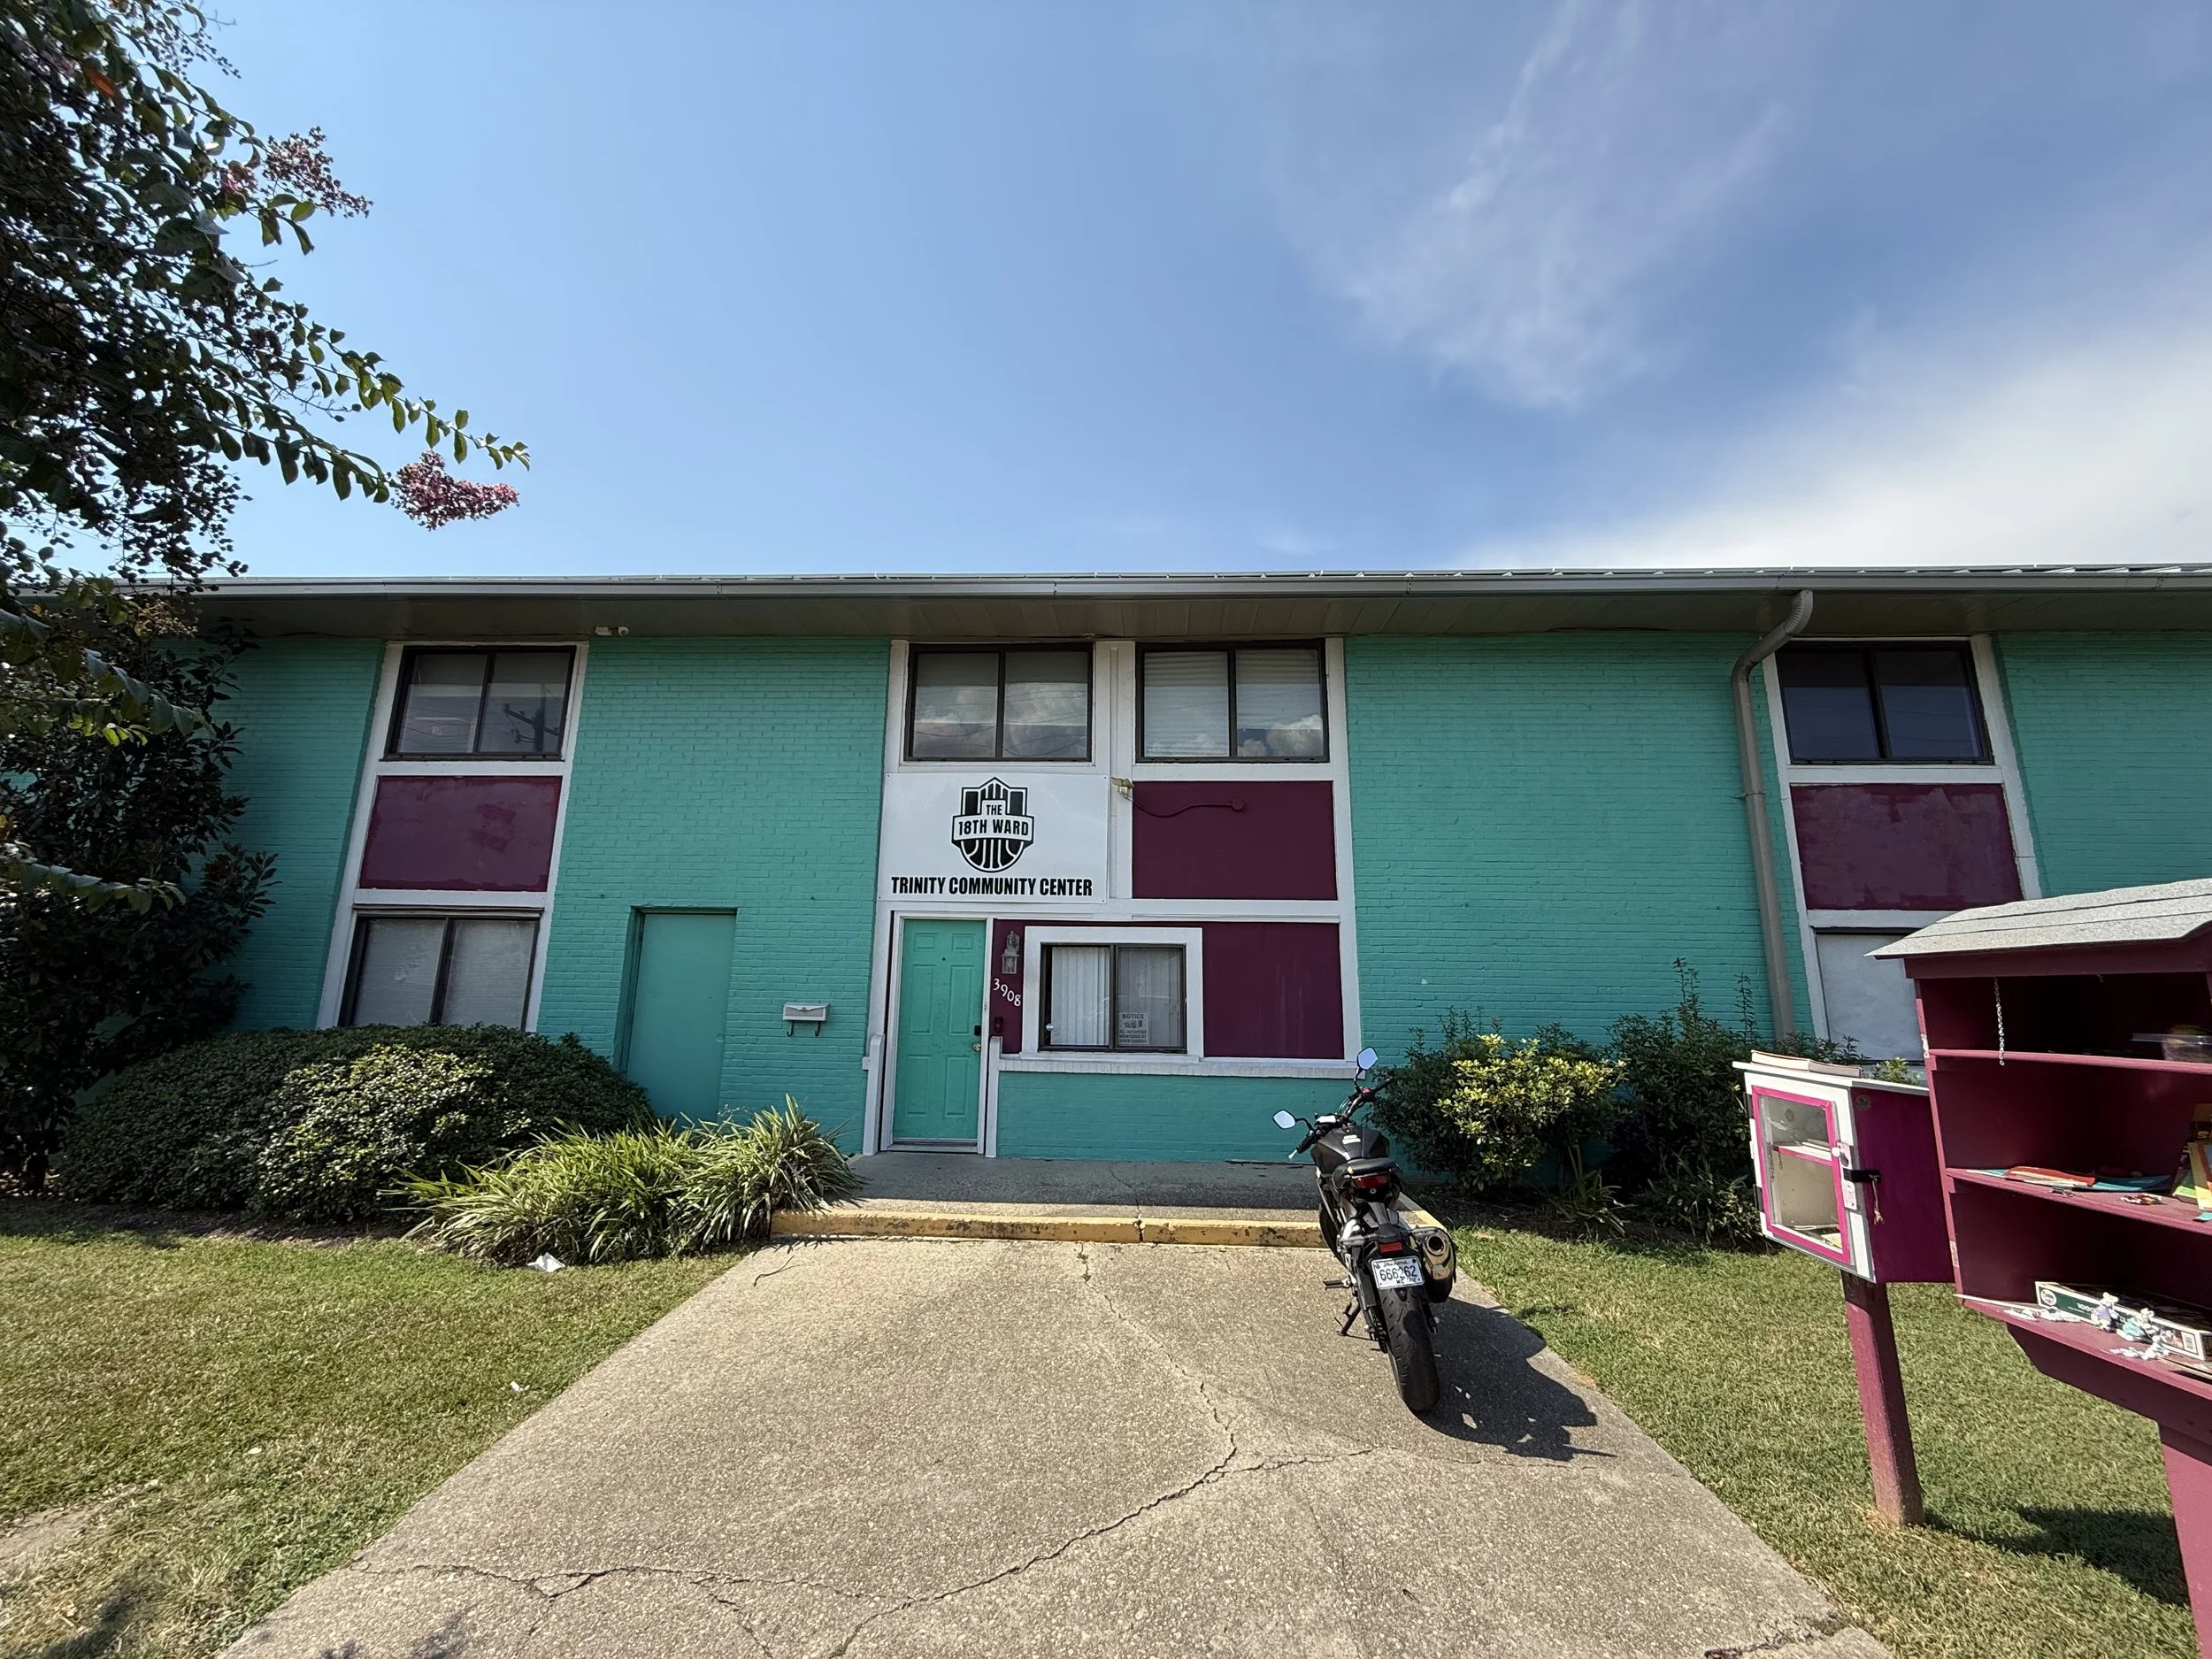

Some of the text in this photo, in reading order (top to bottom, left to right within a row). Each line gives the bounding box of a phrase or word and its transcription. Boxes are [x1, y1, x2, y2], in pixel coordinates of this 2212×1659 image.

[986, 804, 1002, 816] THE
[958, 818, 1029, 836] 18TH WARD
[891, 876, 1093, 896] TRINITY COMMUNITY CENTER
[993, 978, 1021, 1007] 3908
[1379, 1264, 1418, 1281] 666262
